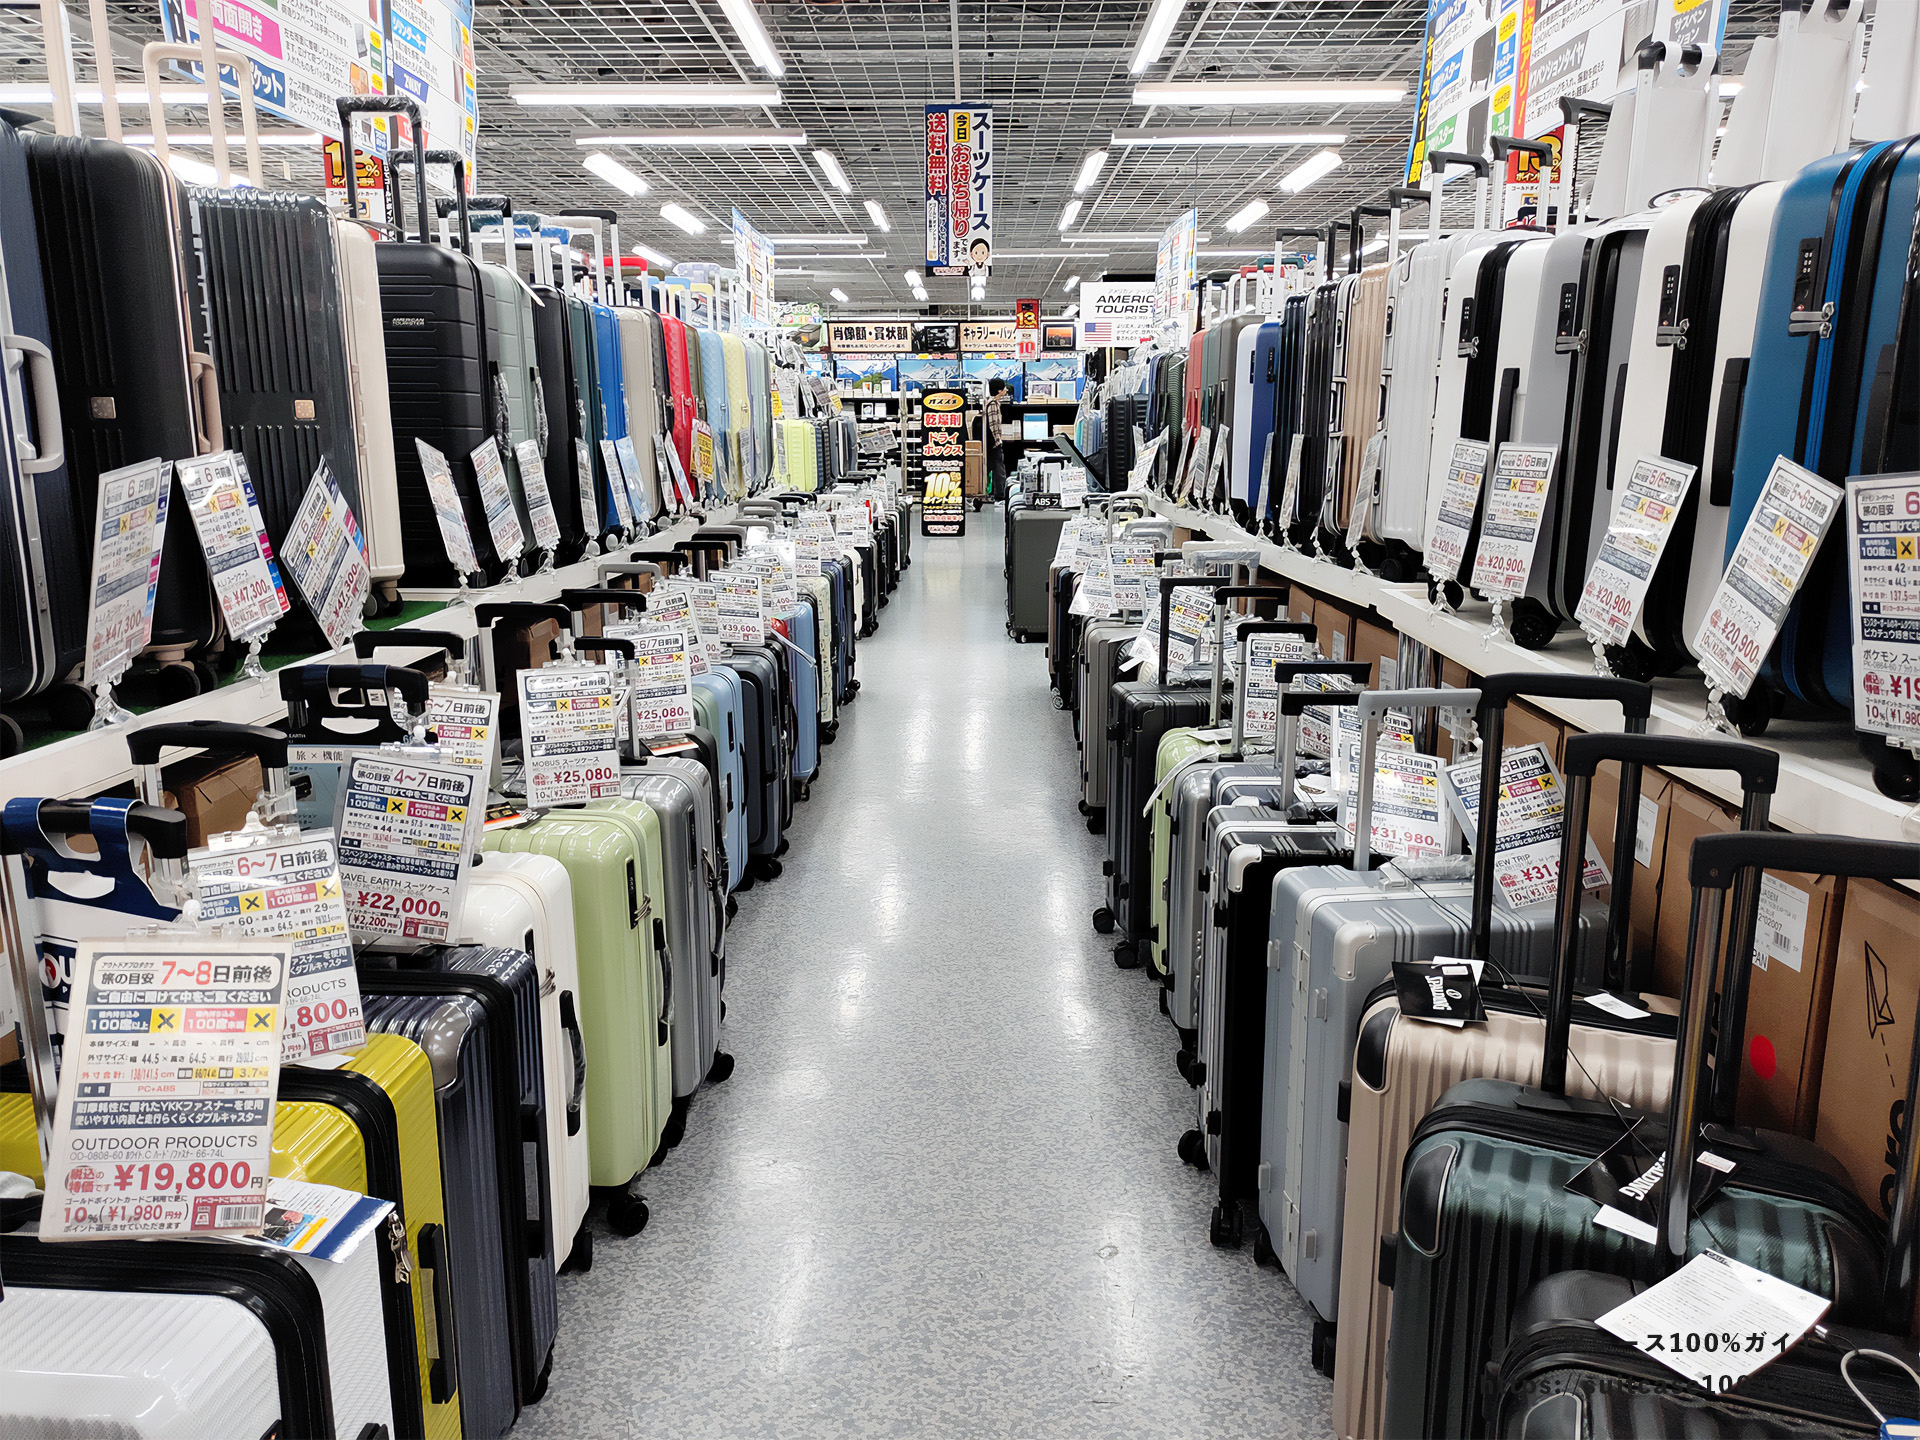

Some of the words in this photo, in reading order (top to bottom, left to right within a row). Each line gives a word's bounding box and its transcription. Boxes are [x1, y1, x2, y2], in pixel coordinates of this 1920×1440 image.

[956, 114, 968, 140] 今日
[928, 113, 947, 195] 送料無料
[972, 112, 991, 231] スーツケース
[952, 144, 971, 238] お持ち帰り
[925, 413, 962, 426] 乾燥剤
[929, 432, 958, 443] ドライ
[923, 445, 963, 455] ボックス
[925, 473, 962, 497] 10%
[1035, 498, 1051, 506] ABS
[1863, 504, 1894, 516] 旅の目安
[1895, 562, 1906, 573] 42
[1863, 649, 1898, 662] ポケモン
[296, 750, 306, 760] 旅
[1512, 854, 1531, 863] TRIP
[370, 875, 402, 889] EARTH
[405, 881, 450, 895] スーツケース
[239, 917, 253, 926] 60
[276, 910, 291, 919] 42
[101, 972, 154, 985] 旅の目安
[97, 990, 272, 1004] ご自由に開けて中をご覧ください
[1424, 975, 1452, 1011] SPALDING
[142, 1052, 159, 1064] 44.5
[189, 1052, 207, 1064] 64.5
[71, 1137, 160, 1150] OUTDOOR
[164, 1136, 258, 1149] PRODUCTS
